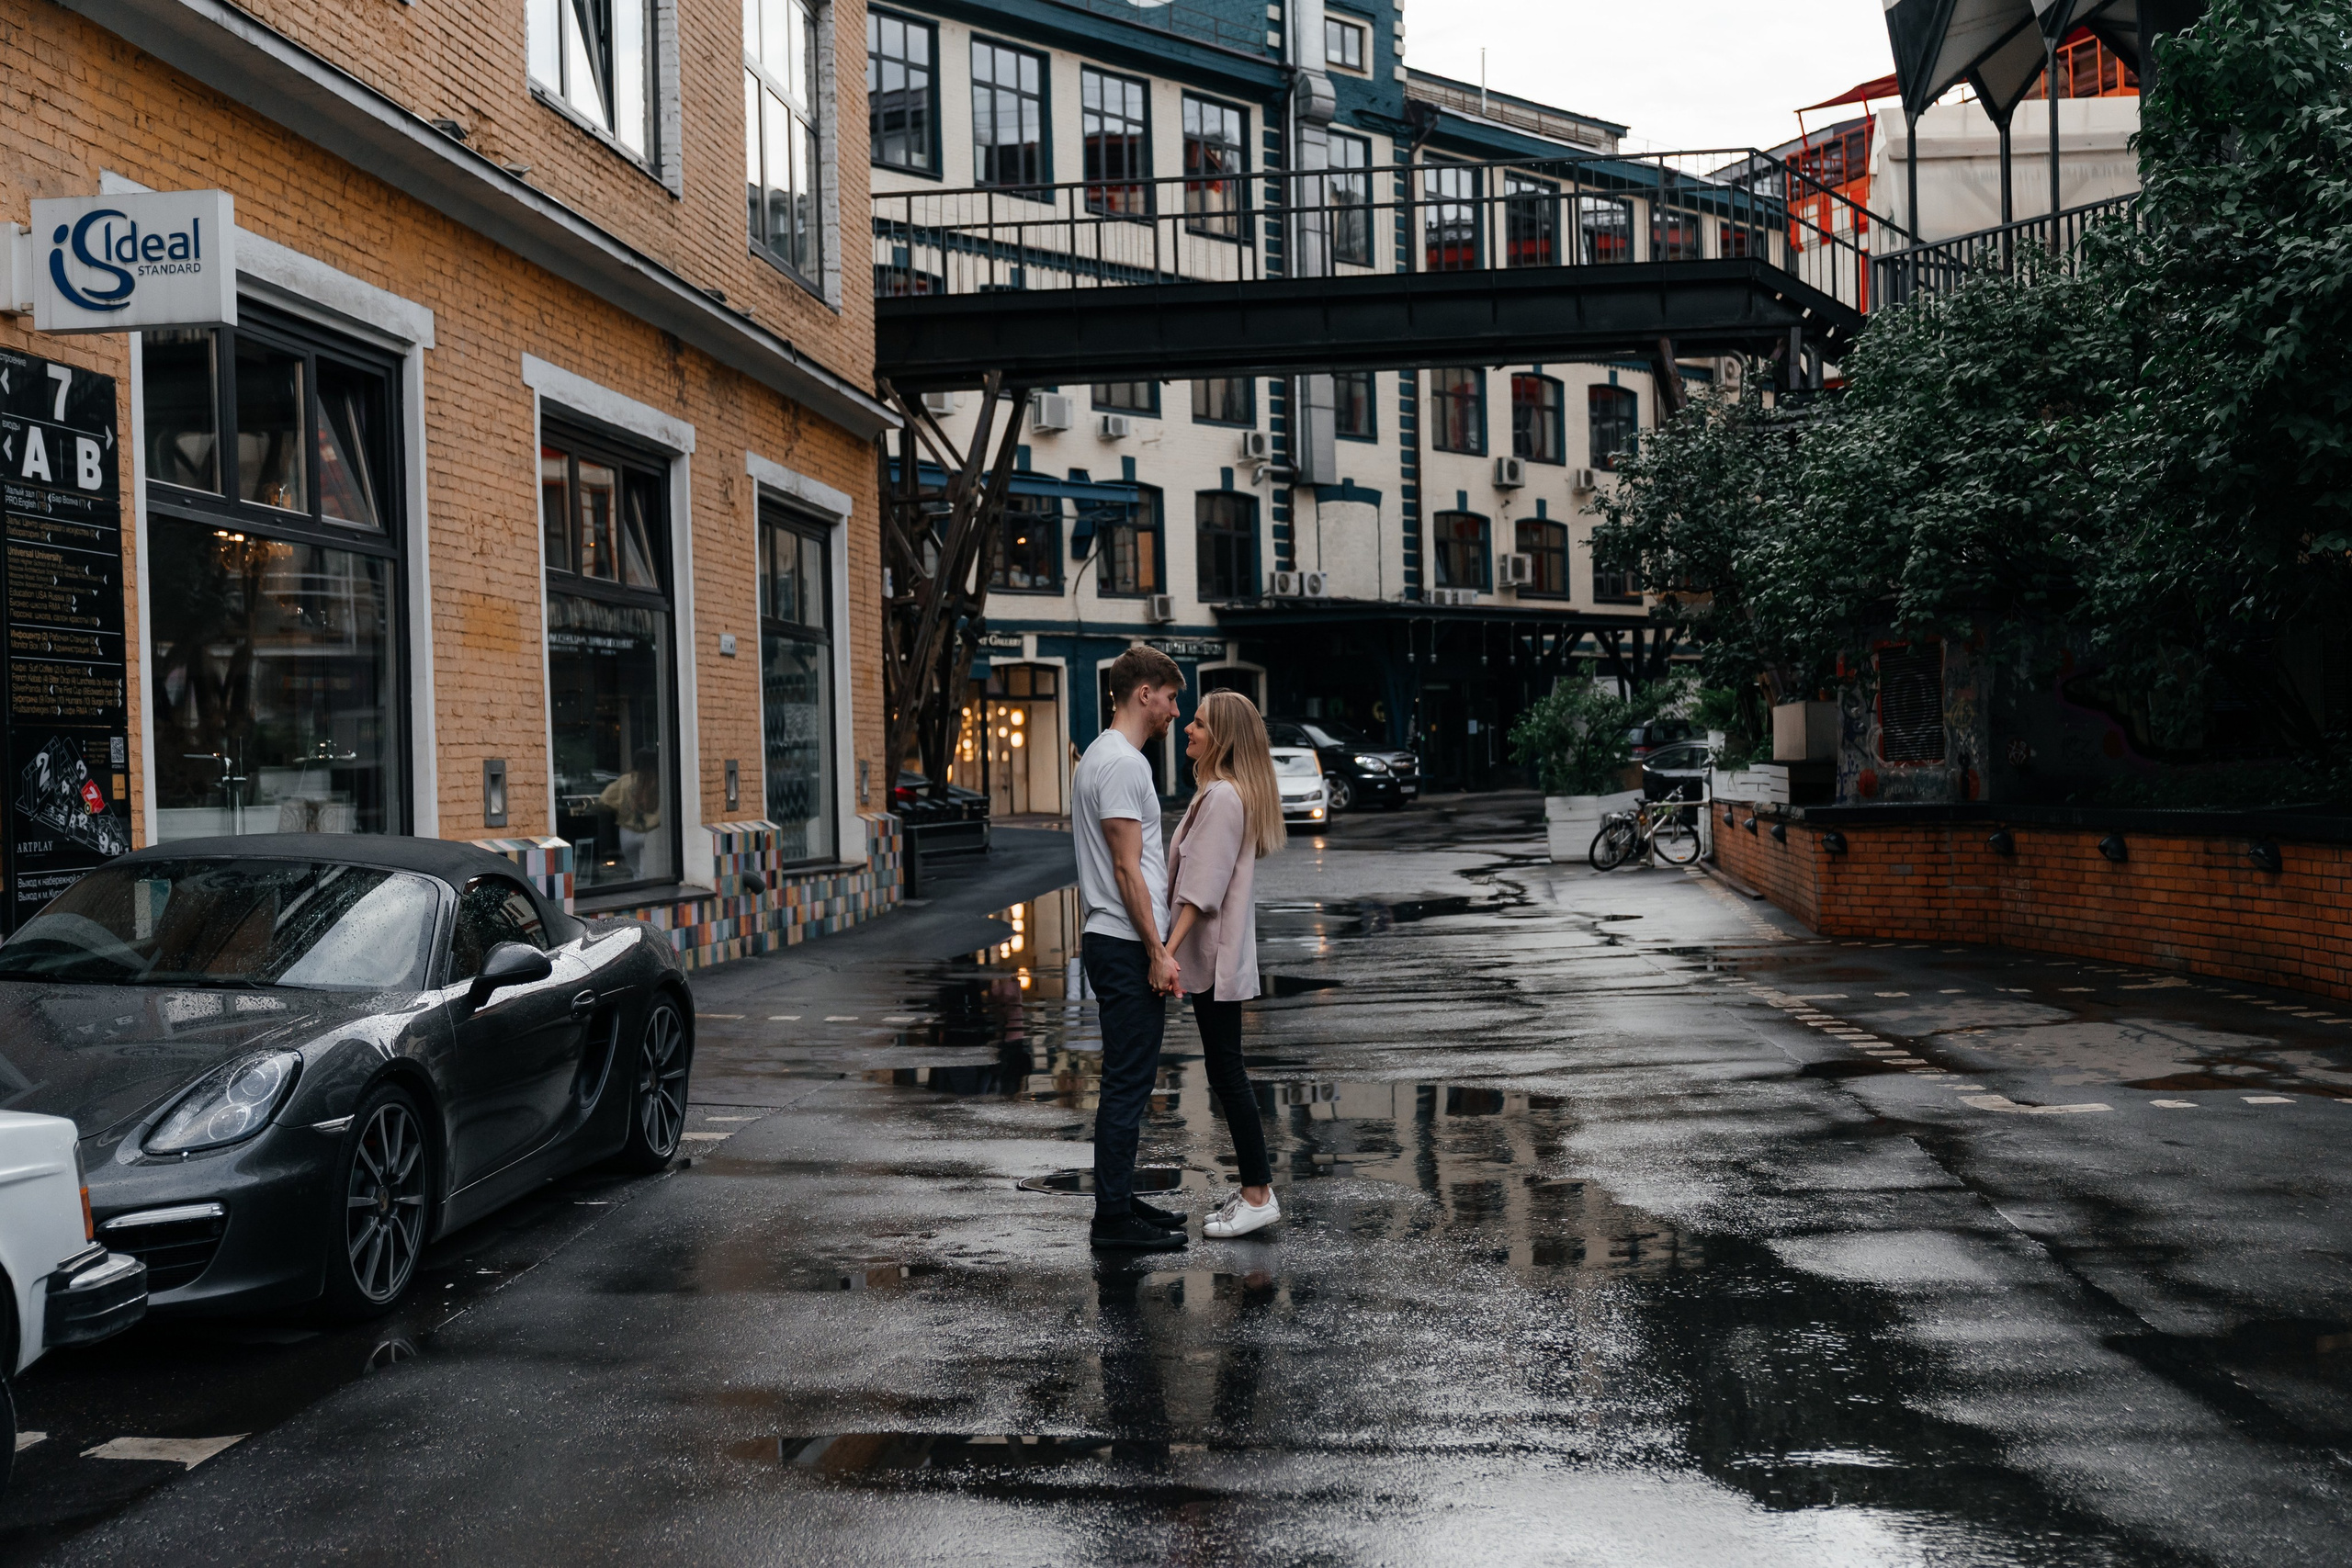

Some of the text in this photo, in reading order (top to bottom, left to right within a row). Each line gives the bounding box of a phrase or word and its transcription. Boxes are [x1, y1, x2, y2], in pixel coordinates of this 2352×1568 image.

[104, 218, 201, 264] Ideal
[138, 263, 201, 276] STANDARD
[47, 363, 72, 422] 7
[2, 420, 20, 431] входы
[21, 425, 102, 491] A B
[5, 494, 37, 510] PRO.English
[25, 490, 35, 499] зал
[51, 492, 62, 503] Бар
[7, 546, 34, 559] Universal
[9, 588, 35, 599] Education
[36, 752, 50, 788] 2
[76, 760, 86, 780] 3
[85, 785, 98, 800] 7
[17, 840, 53, 853] ARTPLAY
[98, 830, 109, 854] 9
[17, 875, 38, 889] Выход
[42, 874, 76, 887] набережной
[17, 889, 38, 902] Выход
